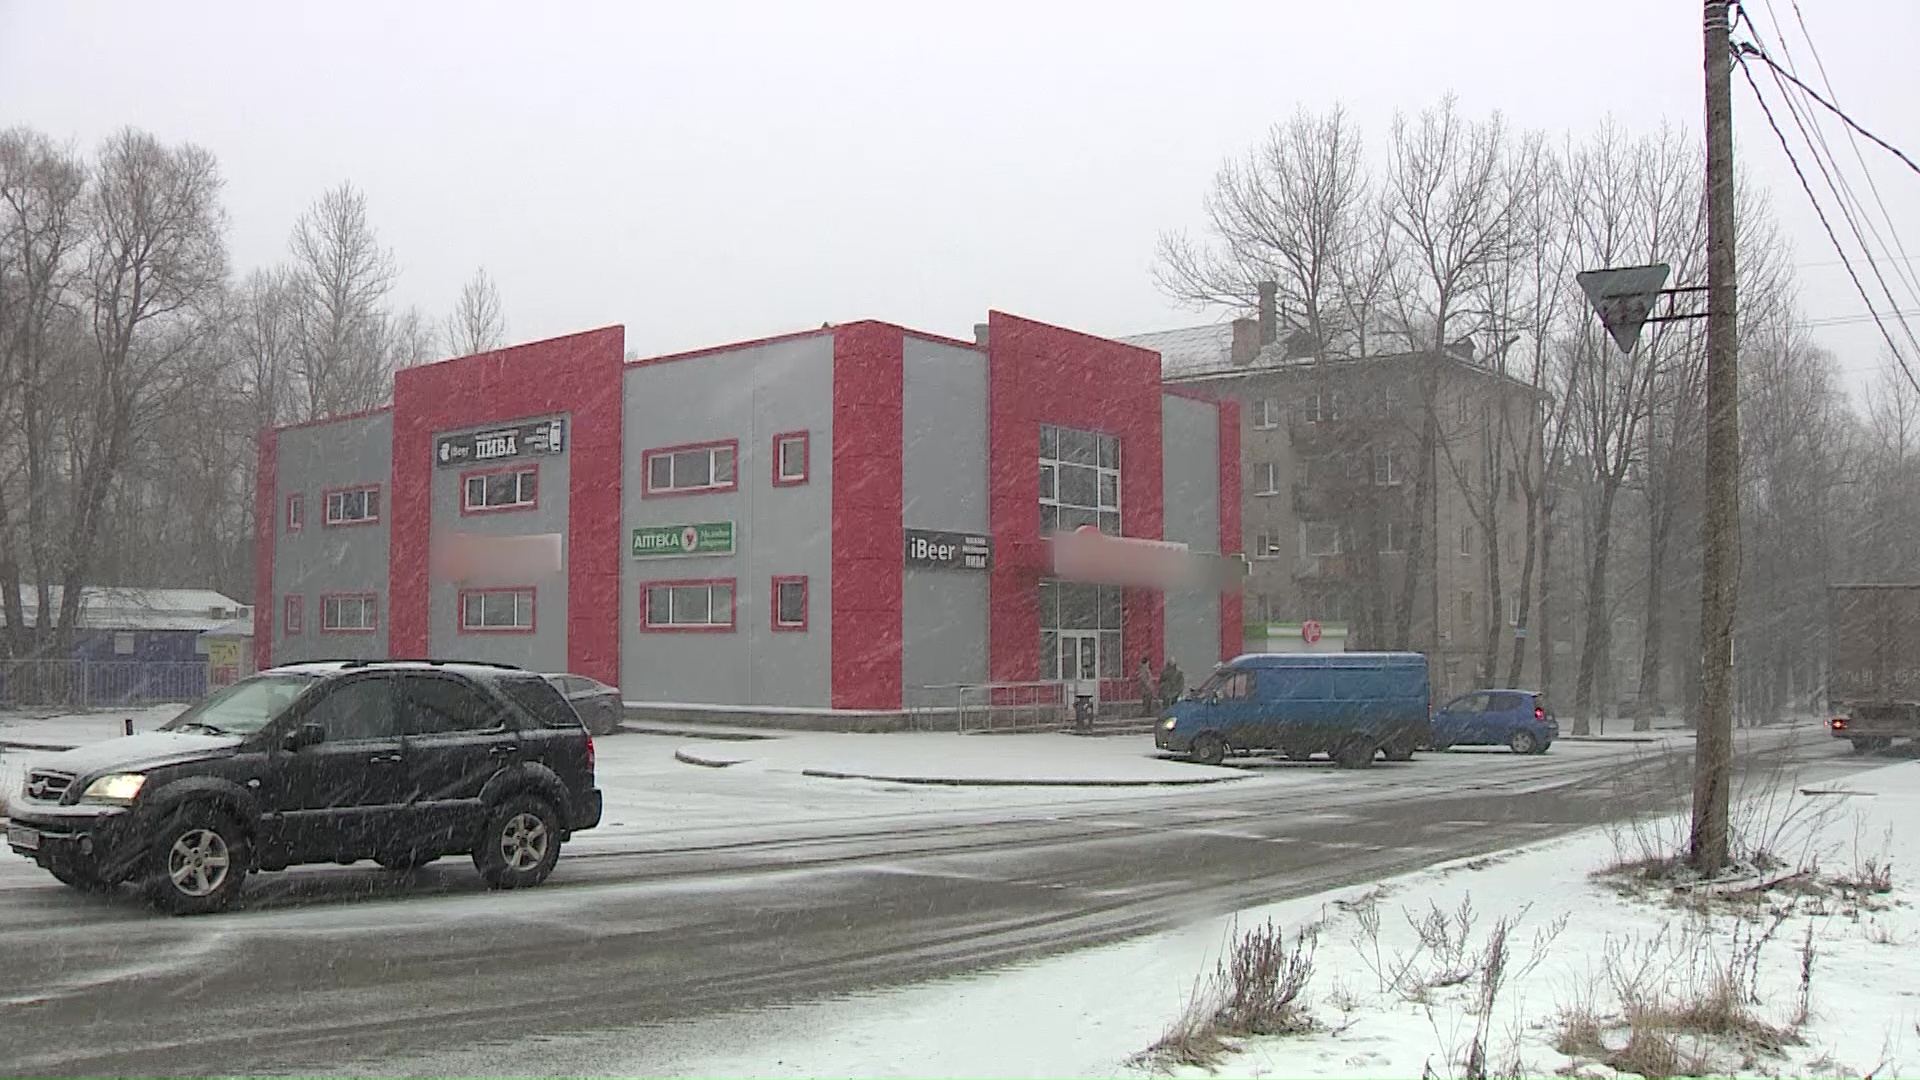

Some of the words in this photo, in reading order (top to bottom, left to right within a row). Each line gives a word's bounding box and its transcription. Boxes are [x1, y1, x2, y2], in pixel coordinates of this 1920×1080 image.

[475, 437, 517, 459] ПИВА
[634, 533, 679, 548] АПТЕКА
[911, 537, 956, 560] iBeer
